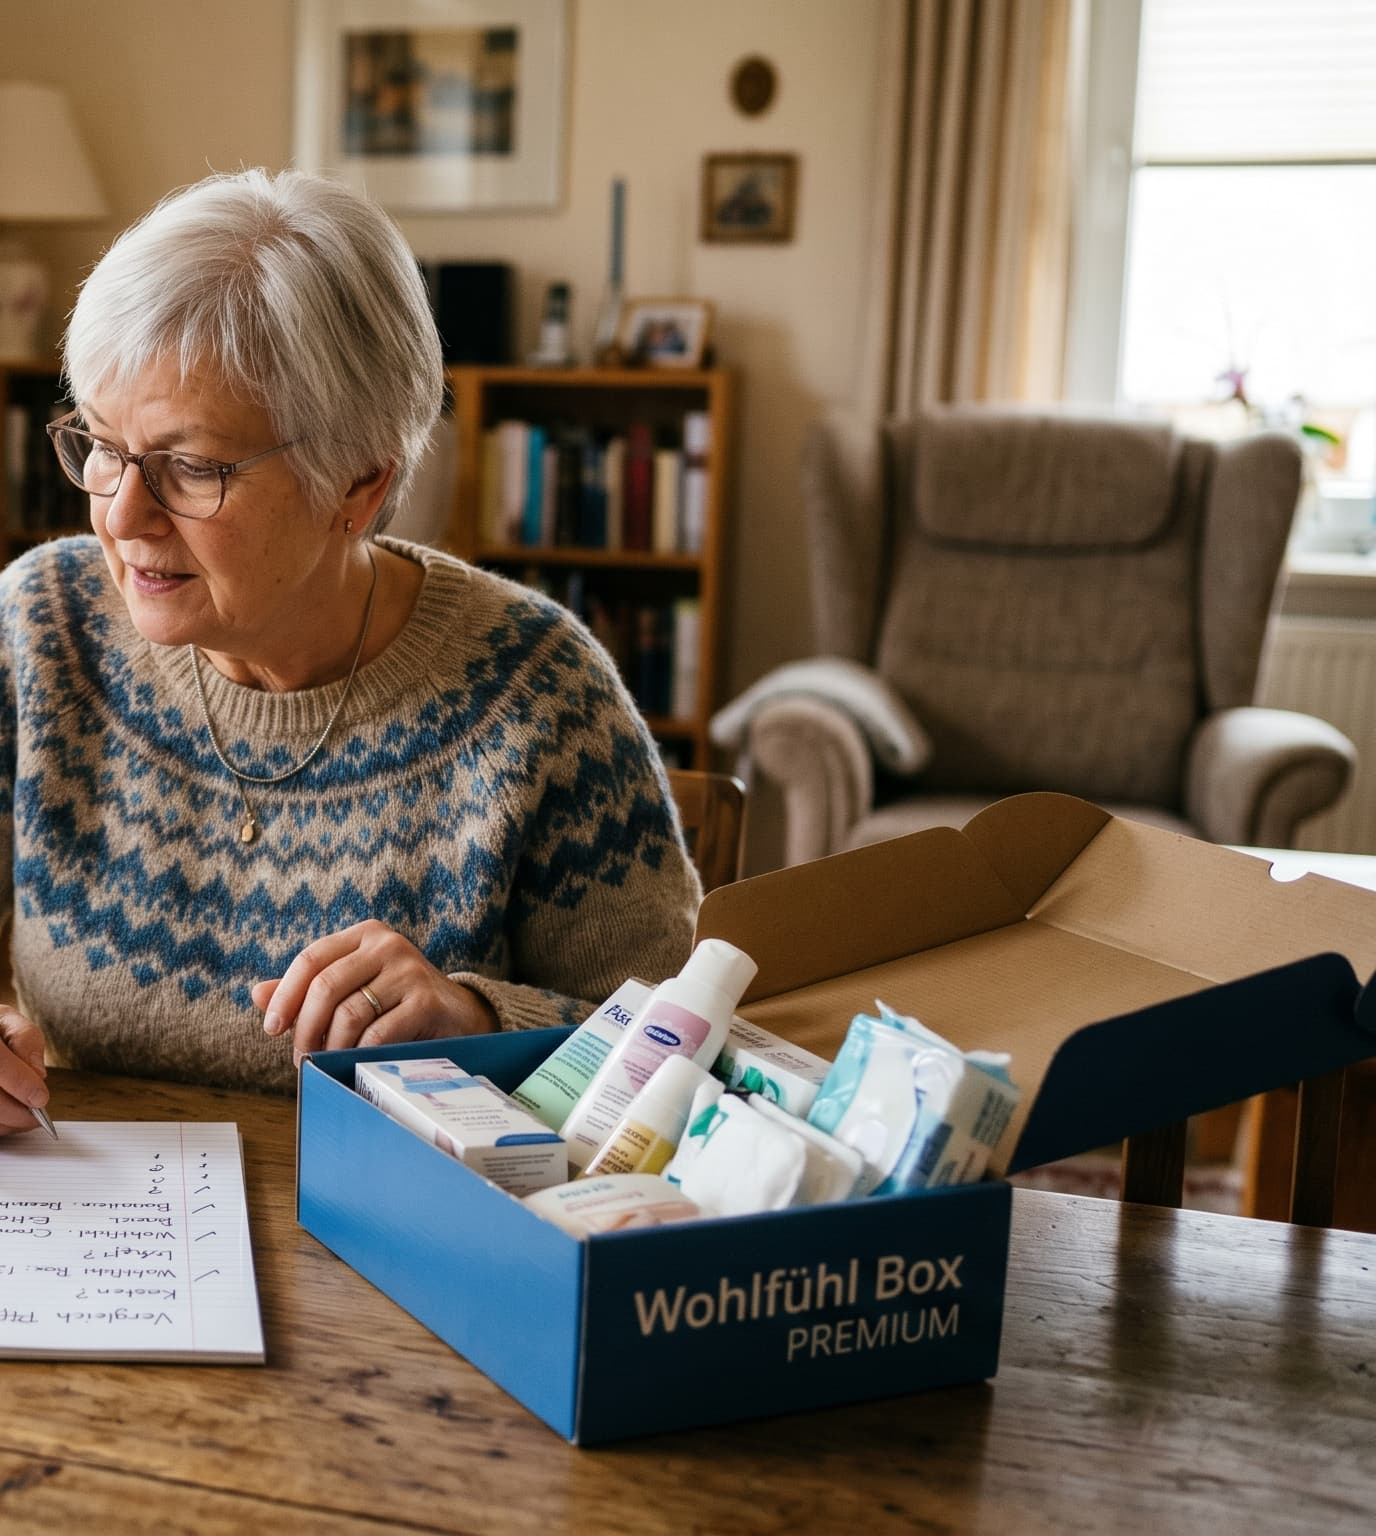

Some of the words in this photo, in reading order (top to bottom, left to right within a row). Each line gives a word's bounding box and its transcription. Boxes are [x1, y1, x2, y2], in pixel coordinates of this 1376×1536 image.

[57, 1309, 173, 1326] Vergleich
[634, 1258, 859, 1336] Wohlfühl
[876, 1255, 965, 1301] Box
[787, 1304, 960, 1363] PREMIUM
